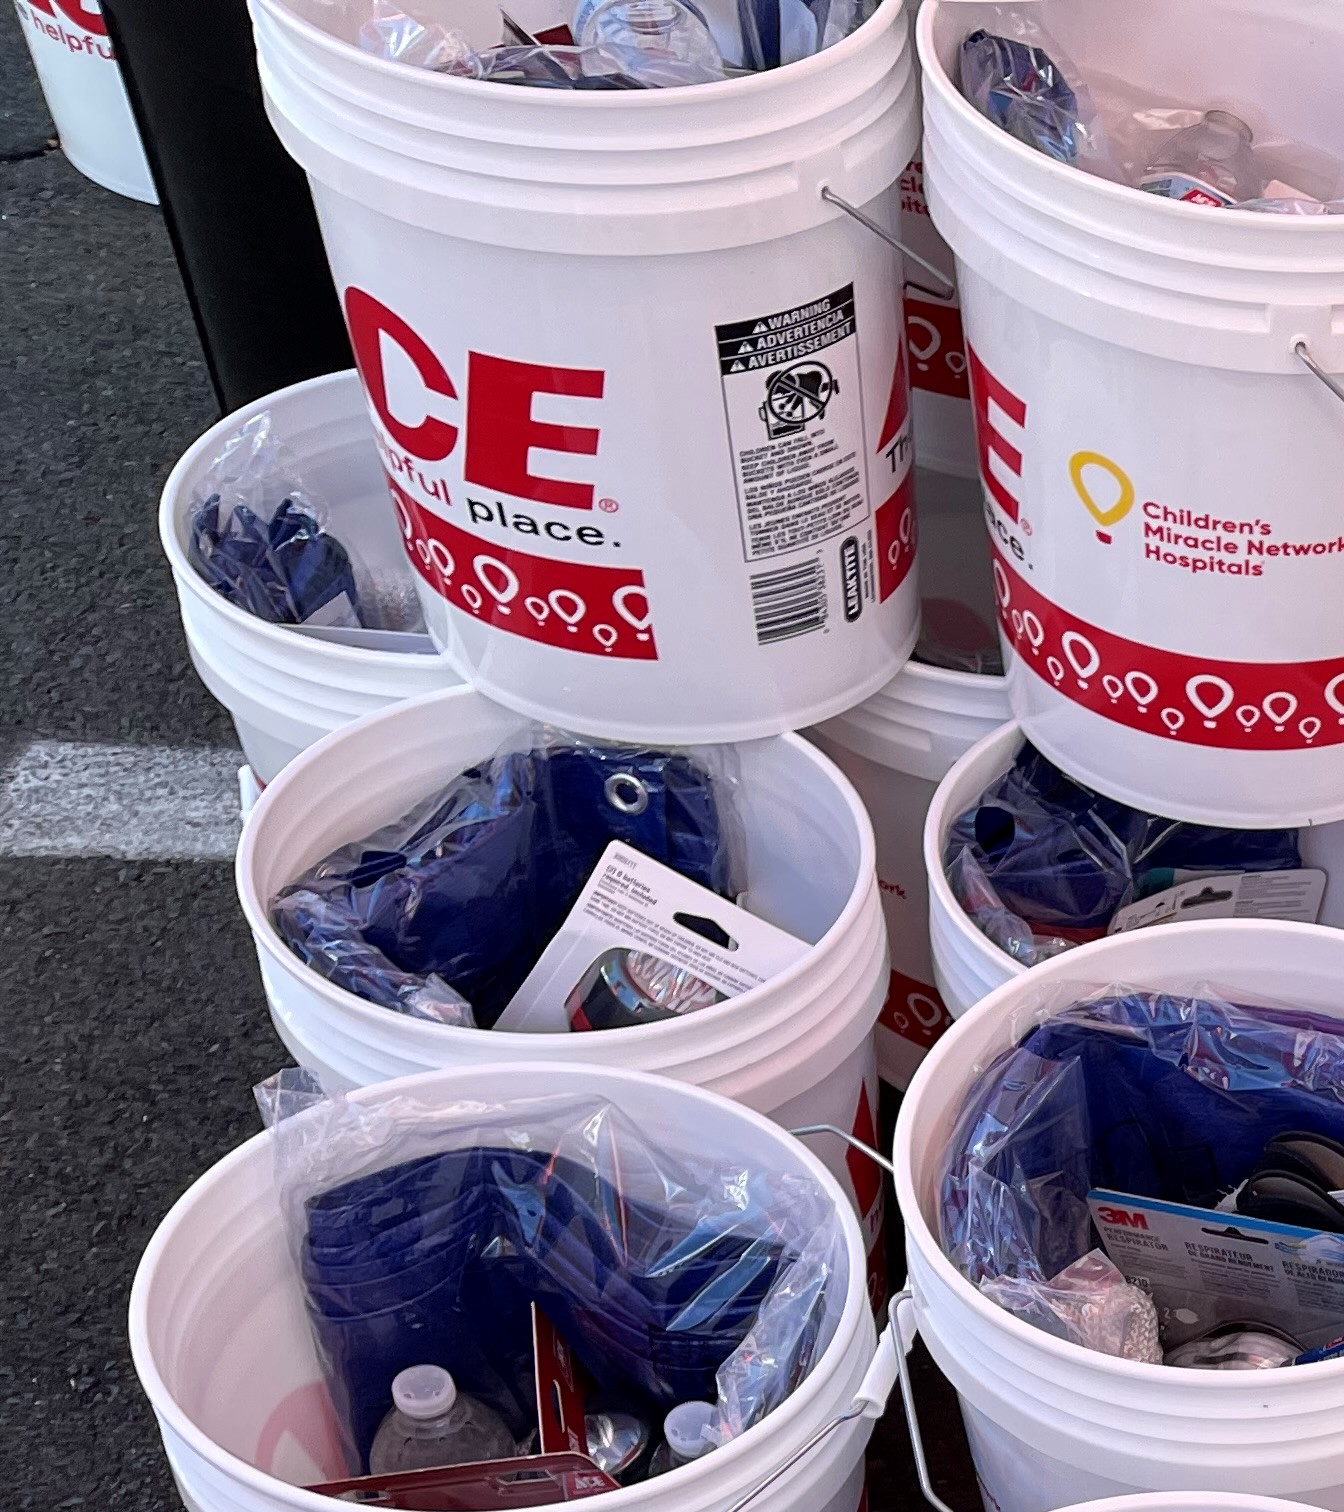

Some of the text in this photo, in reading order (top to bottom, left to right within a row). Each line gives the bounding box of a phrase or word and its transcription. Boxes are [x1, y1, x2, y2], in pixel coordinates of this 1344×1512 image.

[756, 309, 845, 352] ADVERTENCIA
[767, 299, 831, 331] WARNING
[748, 323, 852, 371] AVERTISSEMENT
[465, 497, 621, 548] place.
[1143, 521, 1239, 554] Miracle
[1144, 542, 1264, 576] Hospitals
[1097, 1205, 1150, 1231] 3M
[1106, 1232, 1169, 1251] RESPIRATOR
[1184, 1241, 1254, 1263] RESPIRATEUR
